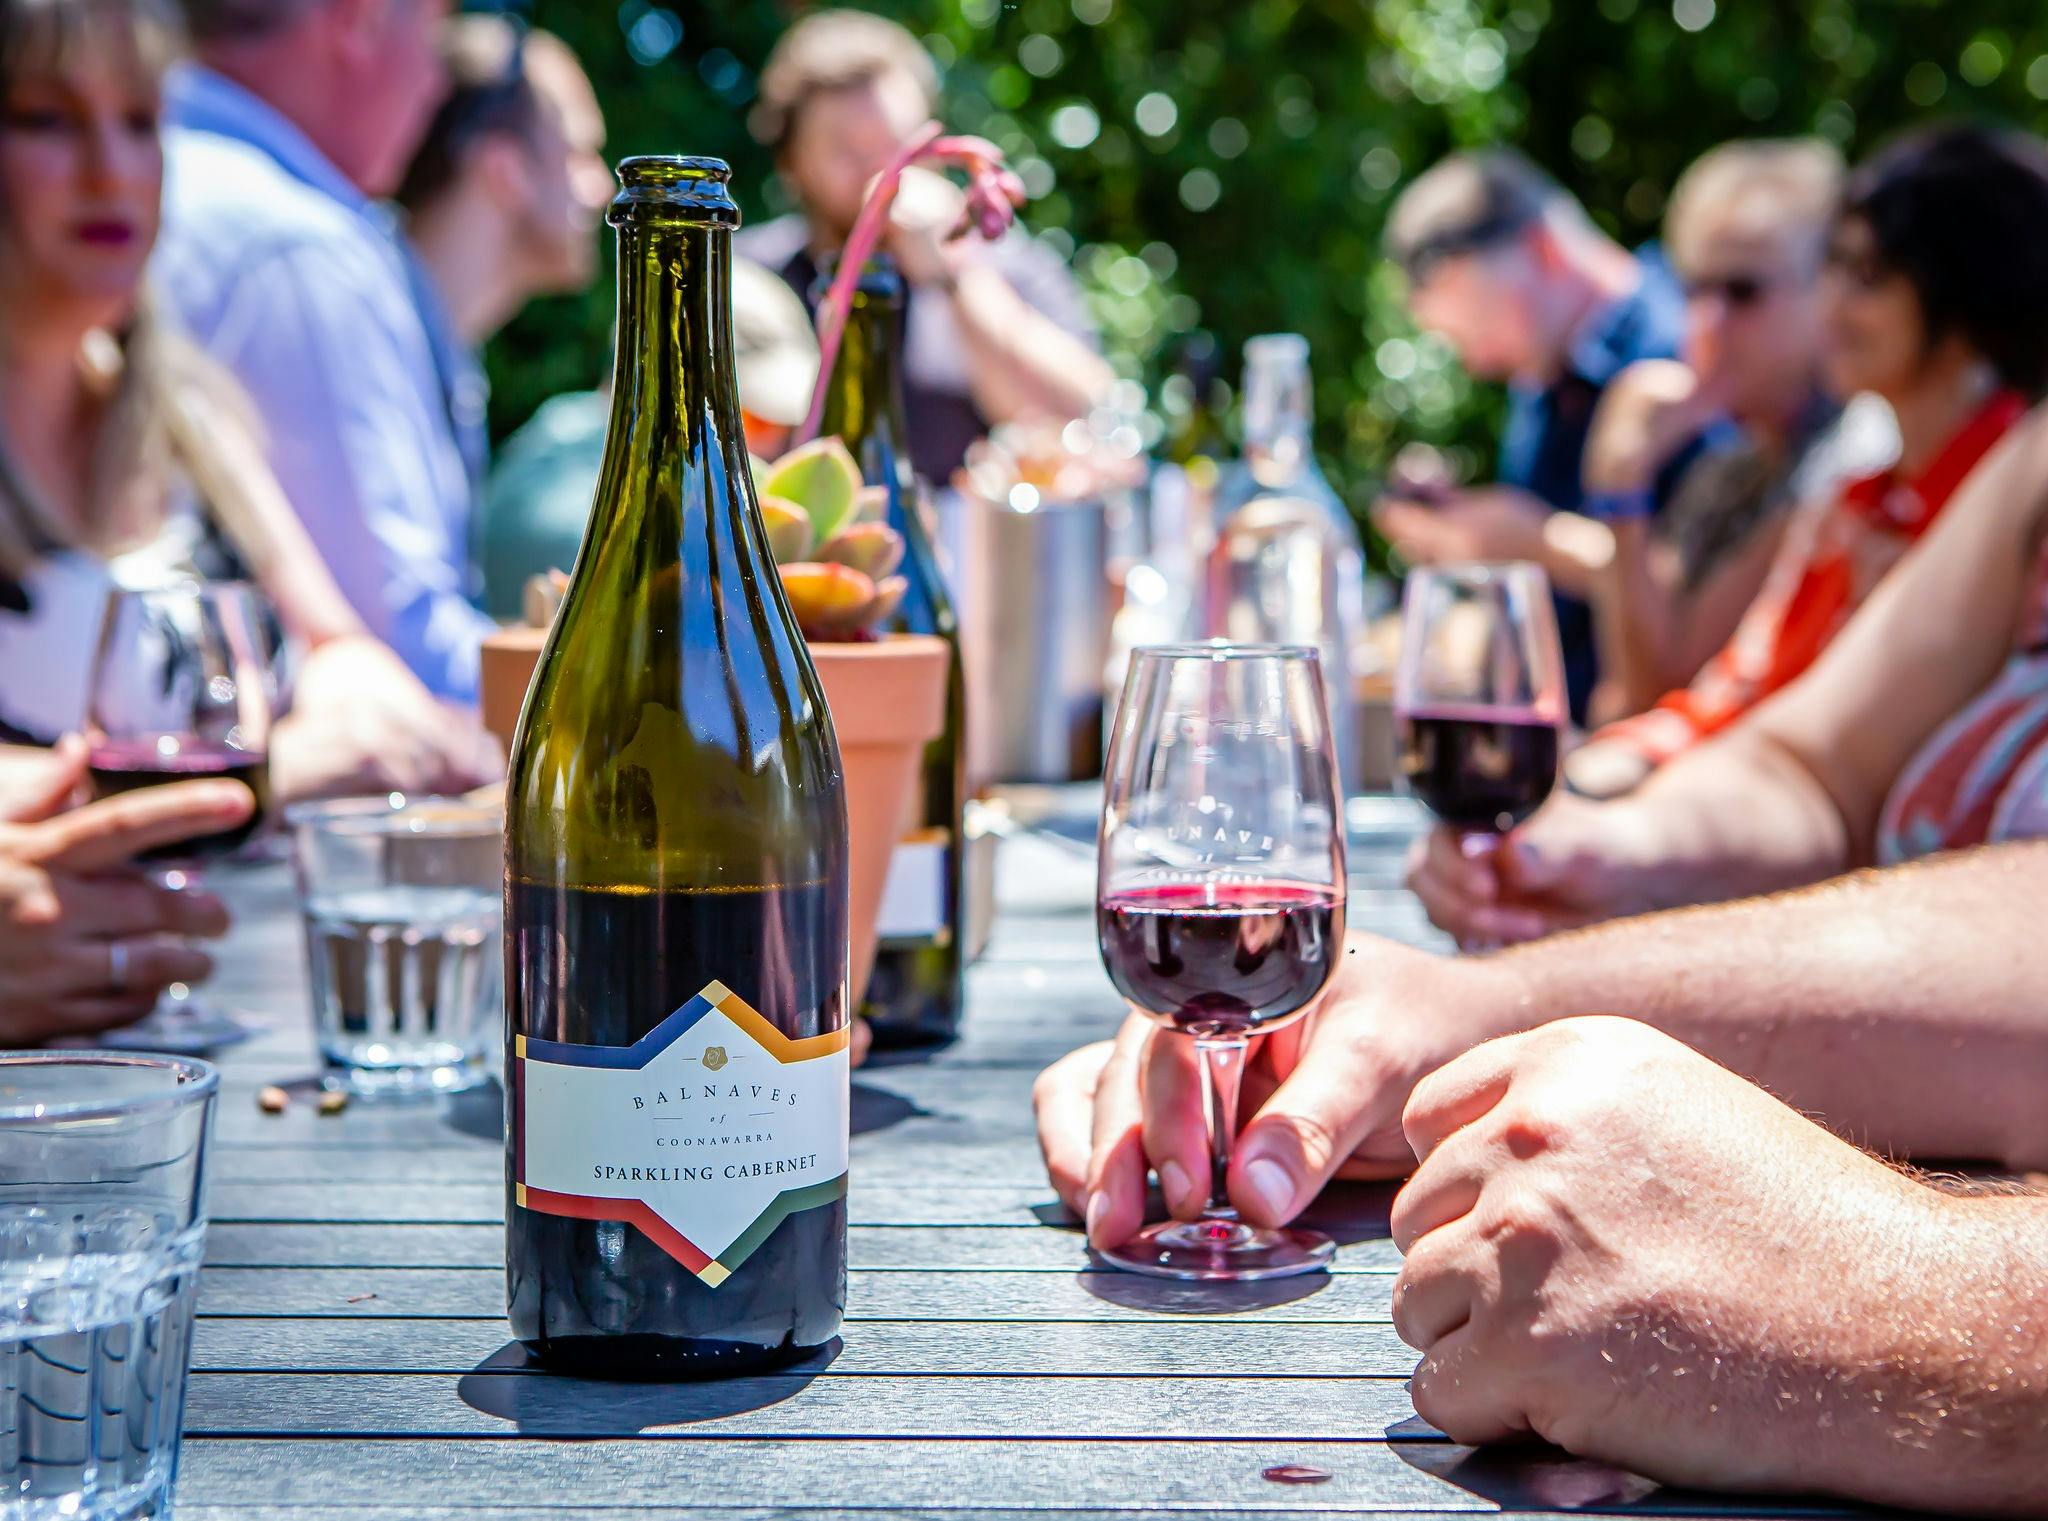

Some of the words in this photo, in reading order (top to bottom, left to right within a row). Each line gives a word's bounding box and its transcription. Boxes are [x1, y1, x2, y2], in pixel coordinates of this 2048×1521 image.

[633, 1084, 797, 1110] BALNAVES
[710, 1114, 727, 1124] of
[656, 1133, 773, 1147] COONAWARRA
[593, 1165, 713, 1181] SPARKLING
[723, 1153, 817, 1179] CABERNET
